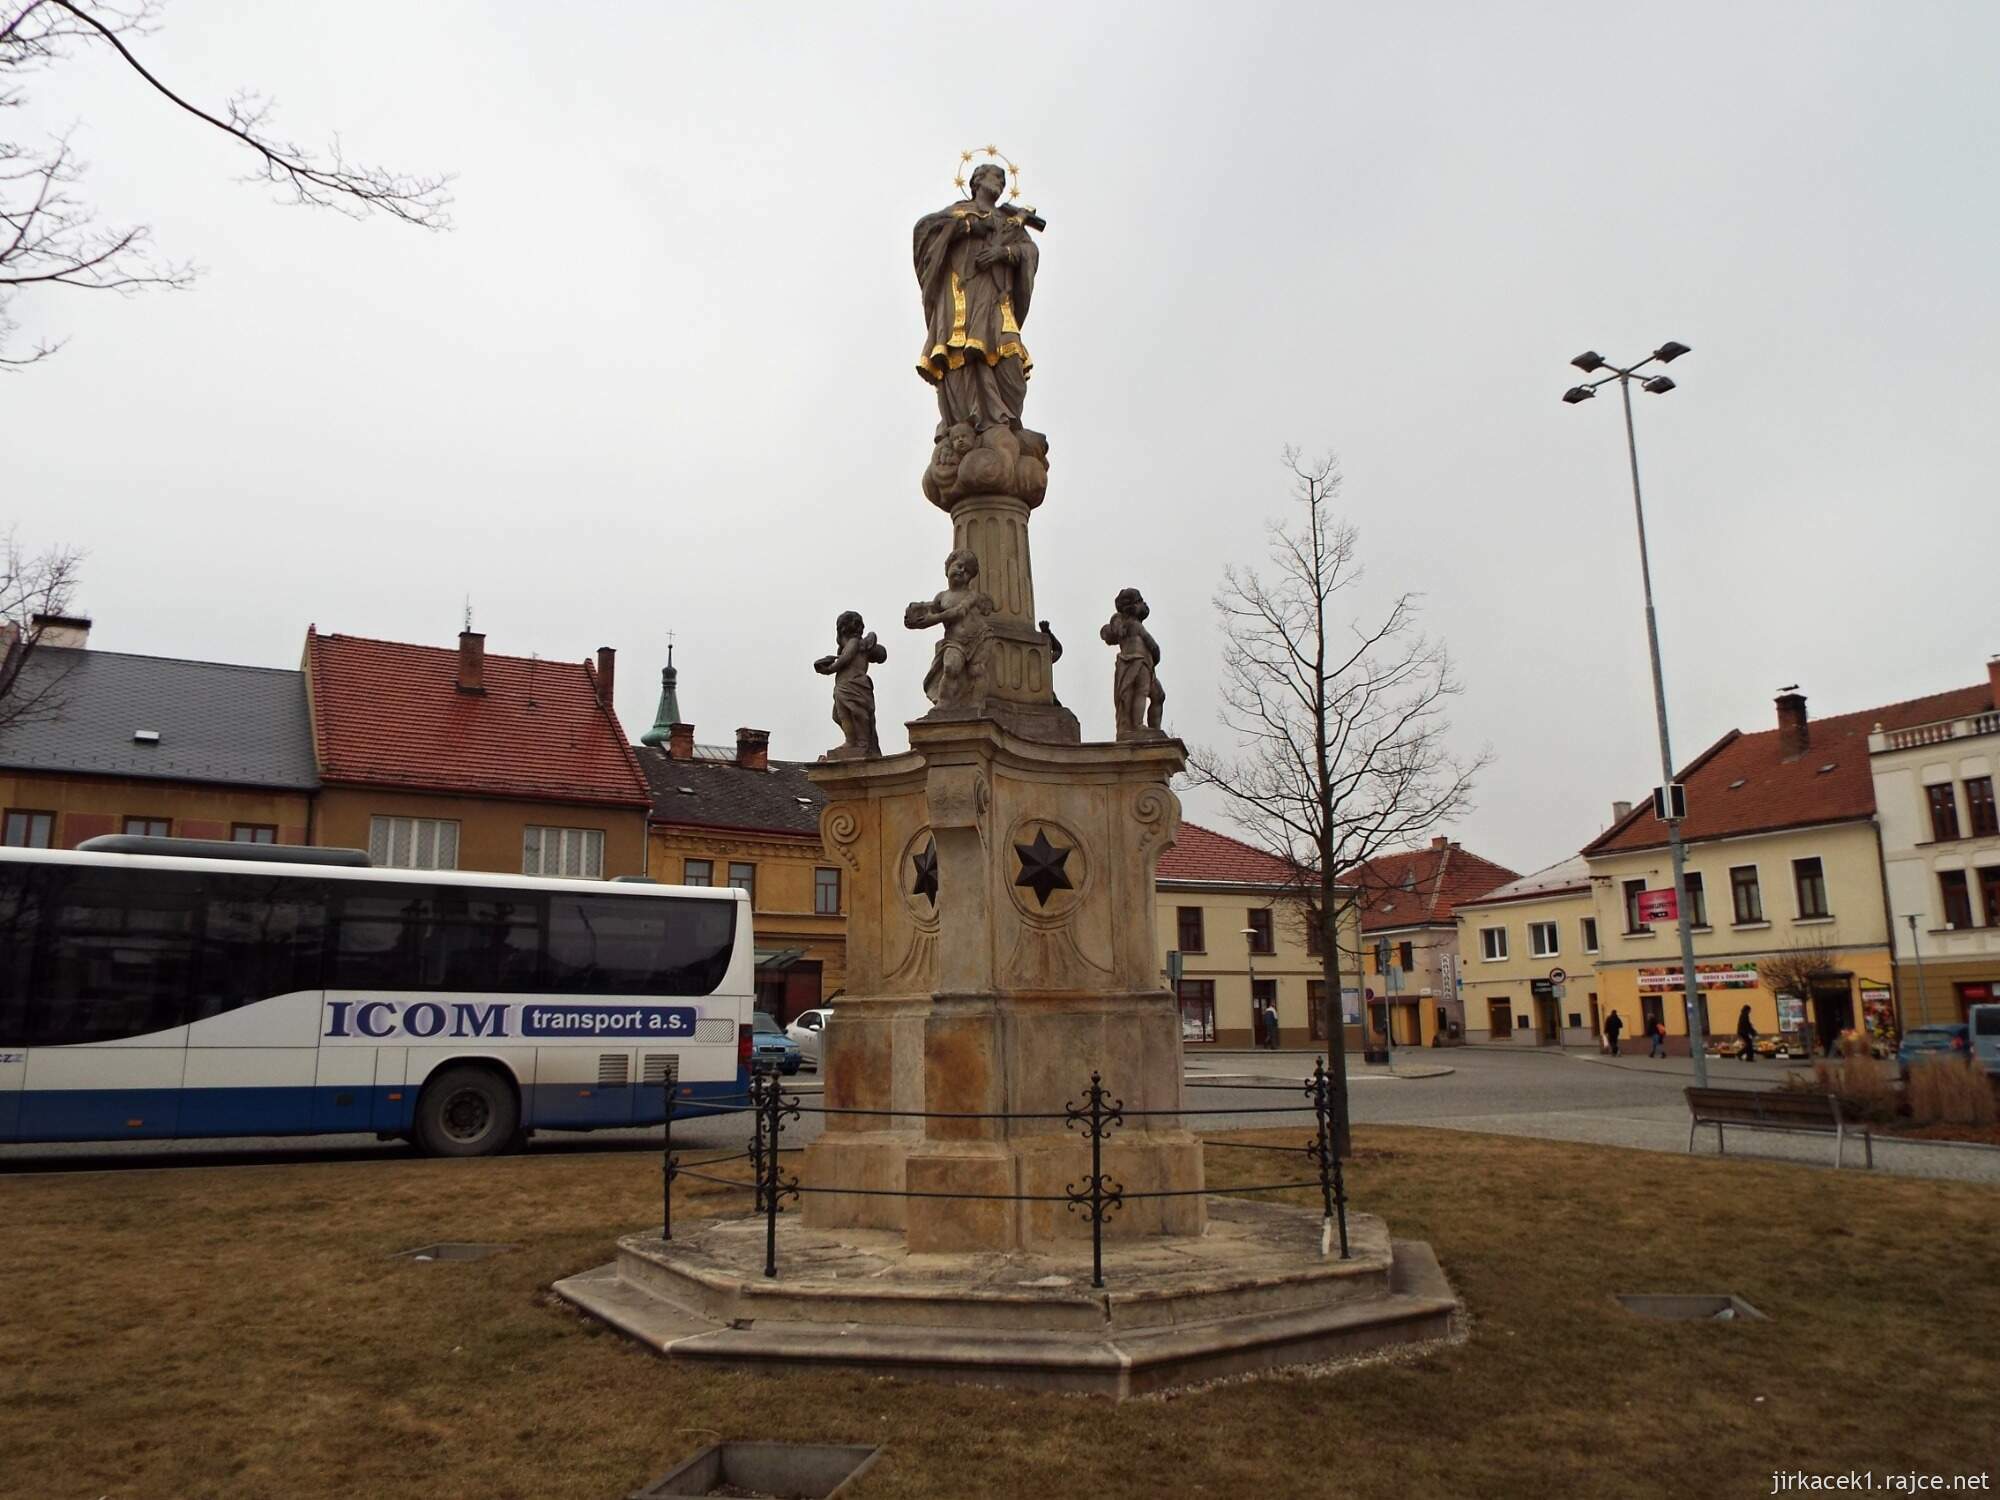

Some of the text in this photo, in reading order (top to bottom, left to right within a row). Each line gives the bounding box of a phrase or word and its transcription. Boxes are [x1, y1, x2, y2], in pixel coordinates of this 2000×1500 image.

[324, 1002, 688, 1037] ICOM transport a.s.
